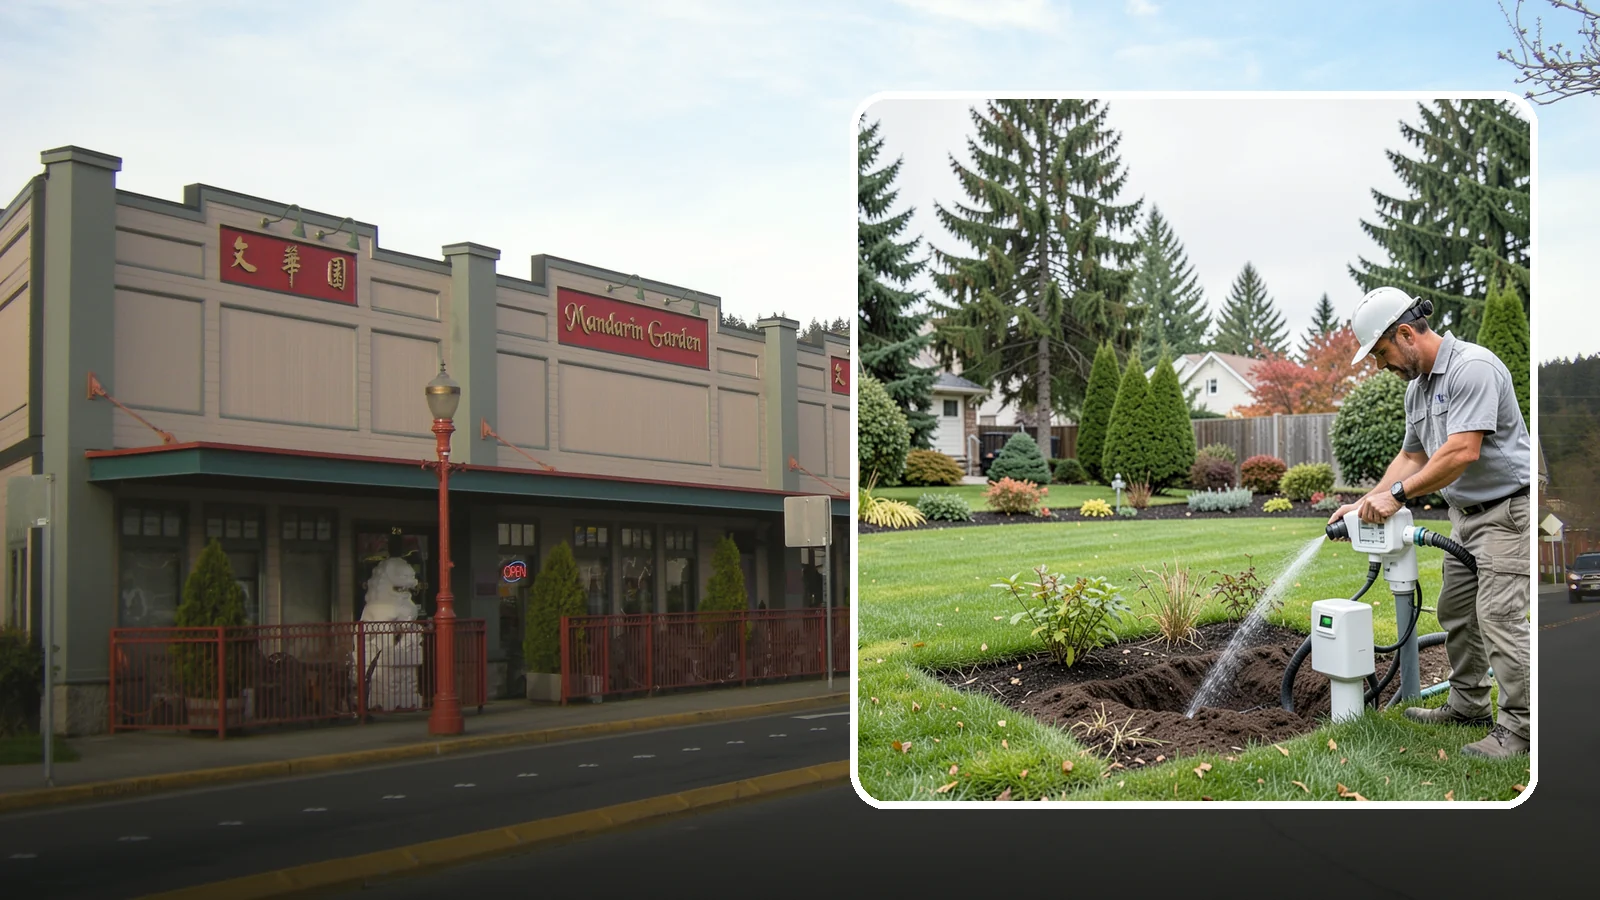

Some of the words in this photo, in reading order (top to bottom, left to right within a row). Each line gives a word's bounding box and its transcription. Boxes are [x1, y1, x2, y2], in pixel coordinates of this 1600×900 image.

[230, 235, 346, 291] 文華園
[564, 302, 644, 341] Mandarin
[648, 320, 702, 352] Garden
[503, 565, 527, 578] OPEN
